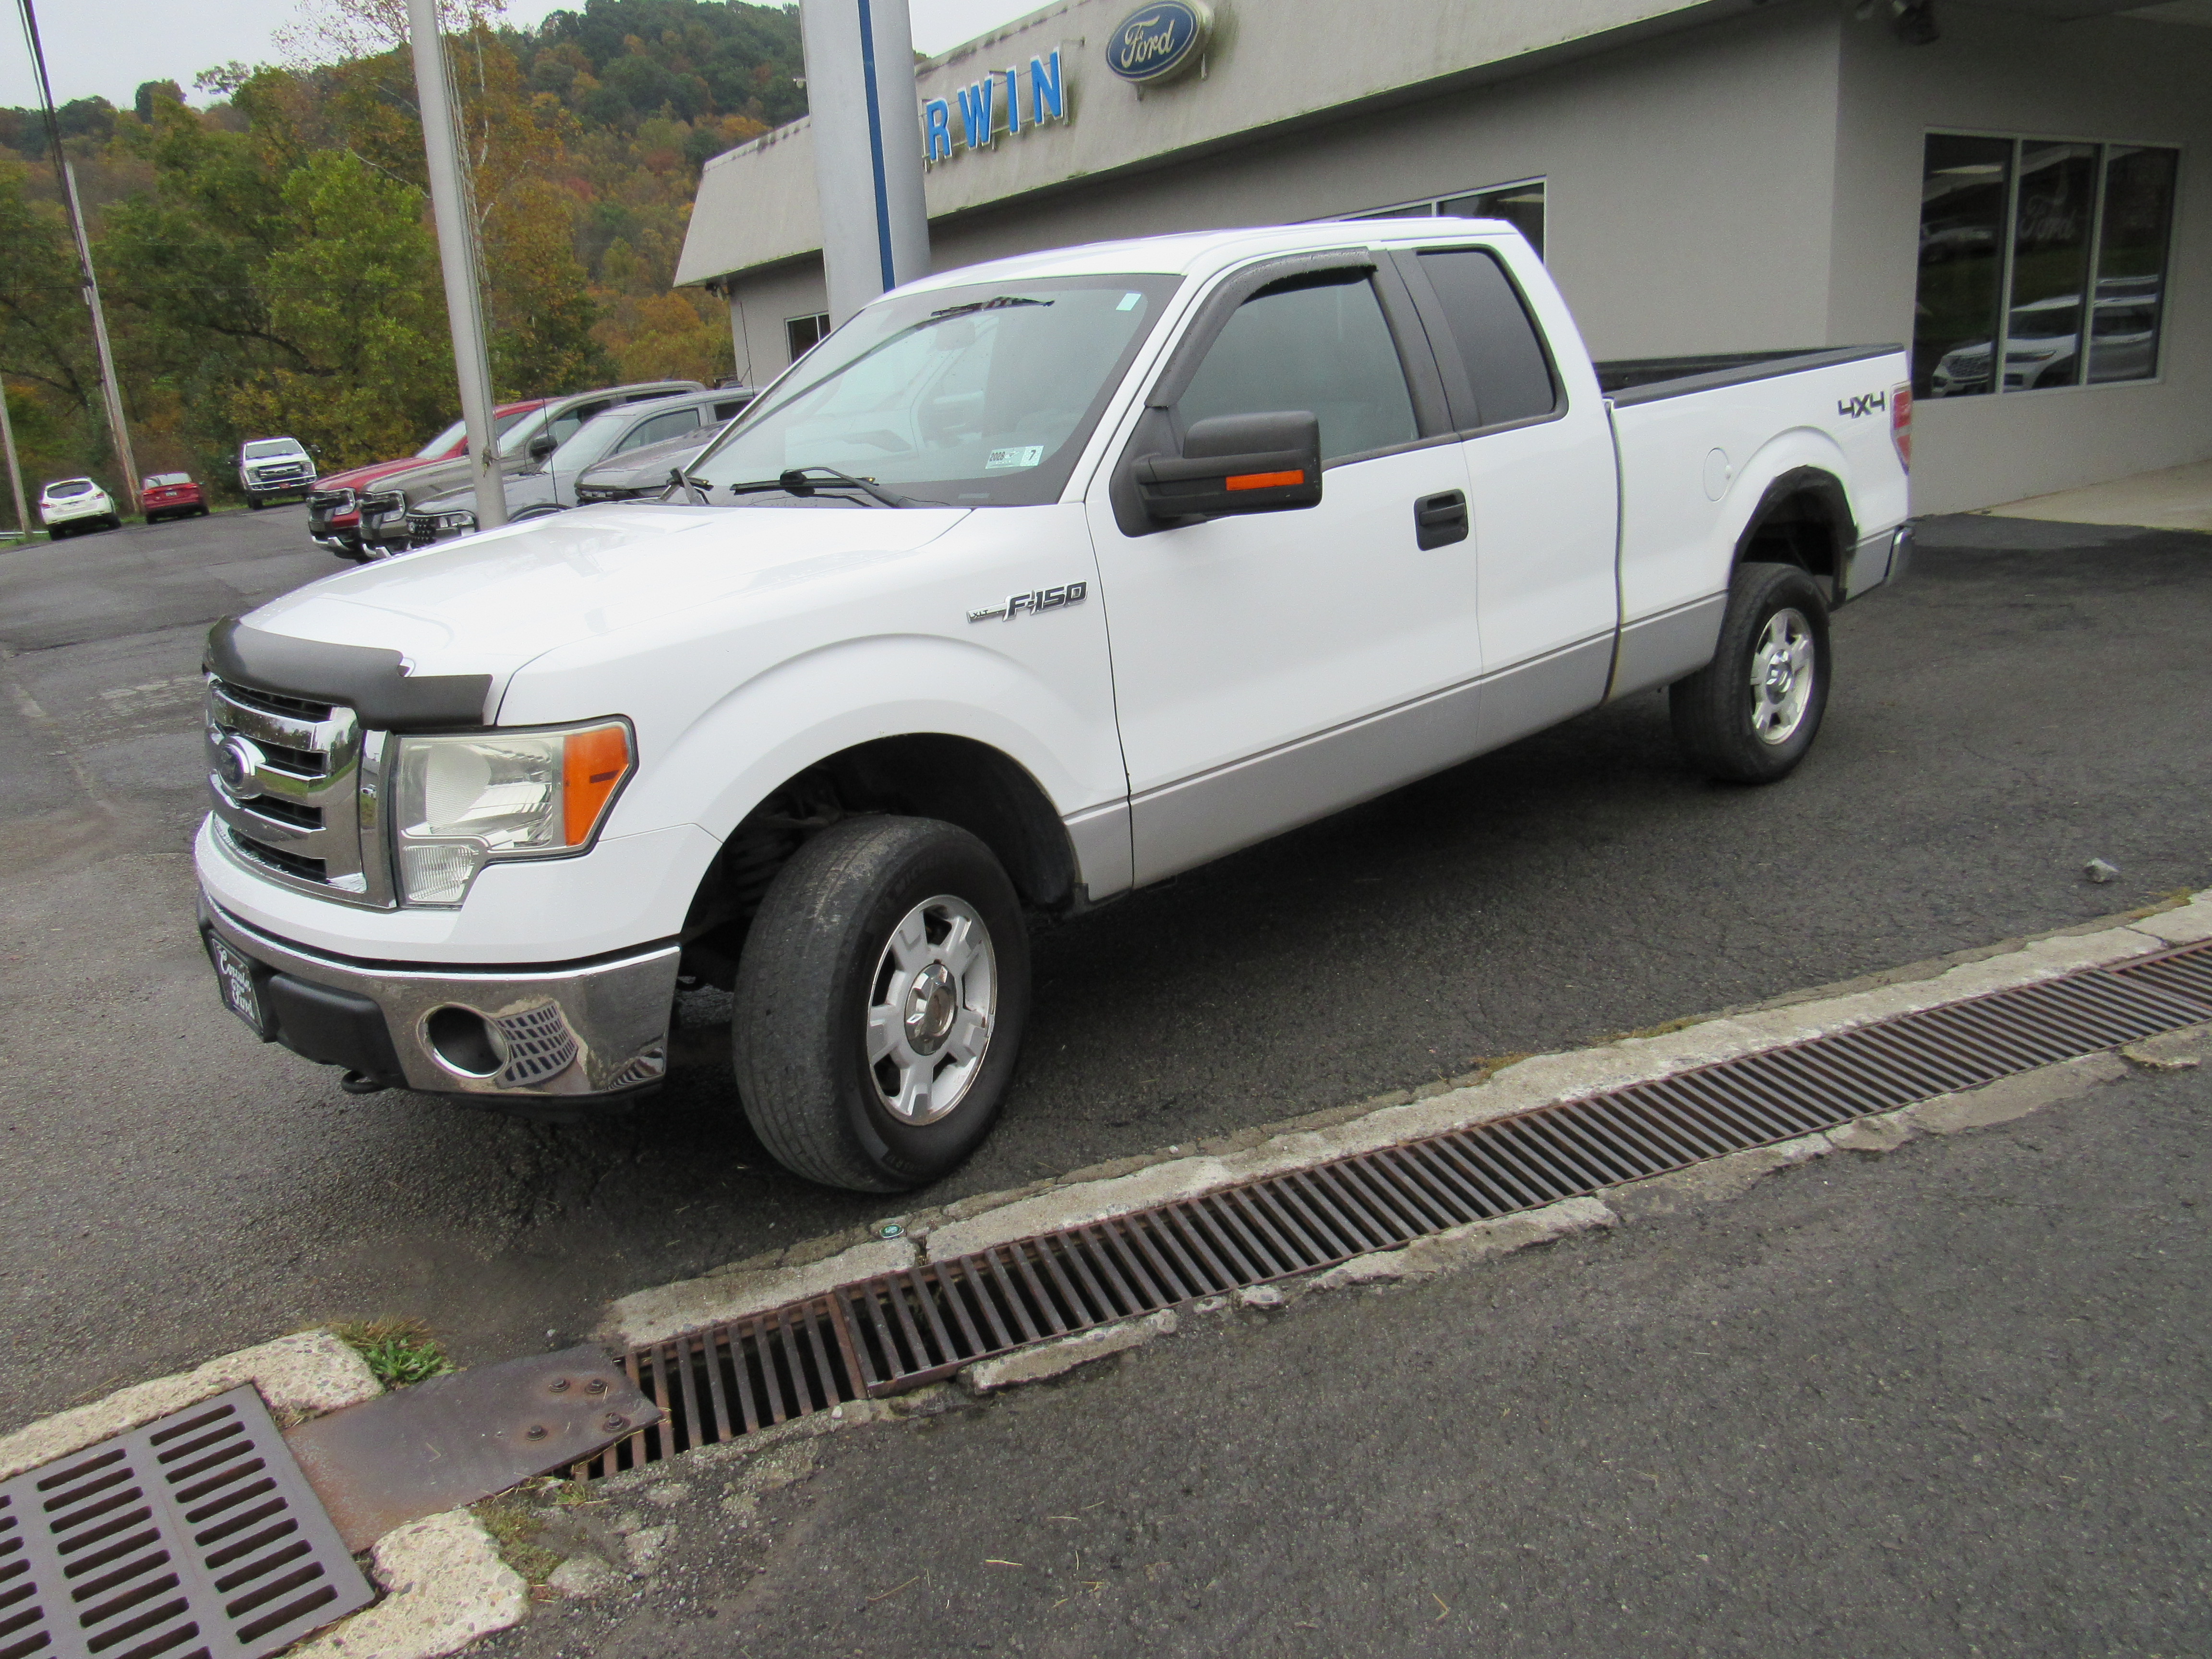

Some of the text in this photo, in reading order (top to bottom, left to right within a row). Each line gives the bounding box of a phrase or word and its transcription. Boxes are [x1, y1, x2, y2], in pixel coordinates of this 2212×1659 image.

[1121, 15, 1176, 68] Ford
[1028, 450, 1036, 461] 7
[973, 579, 1088, 622] XLT F-150
